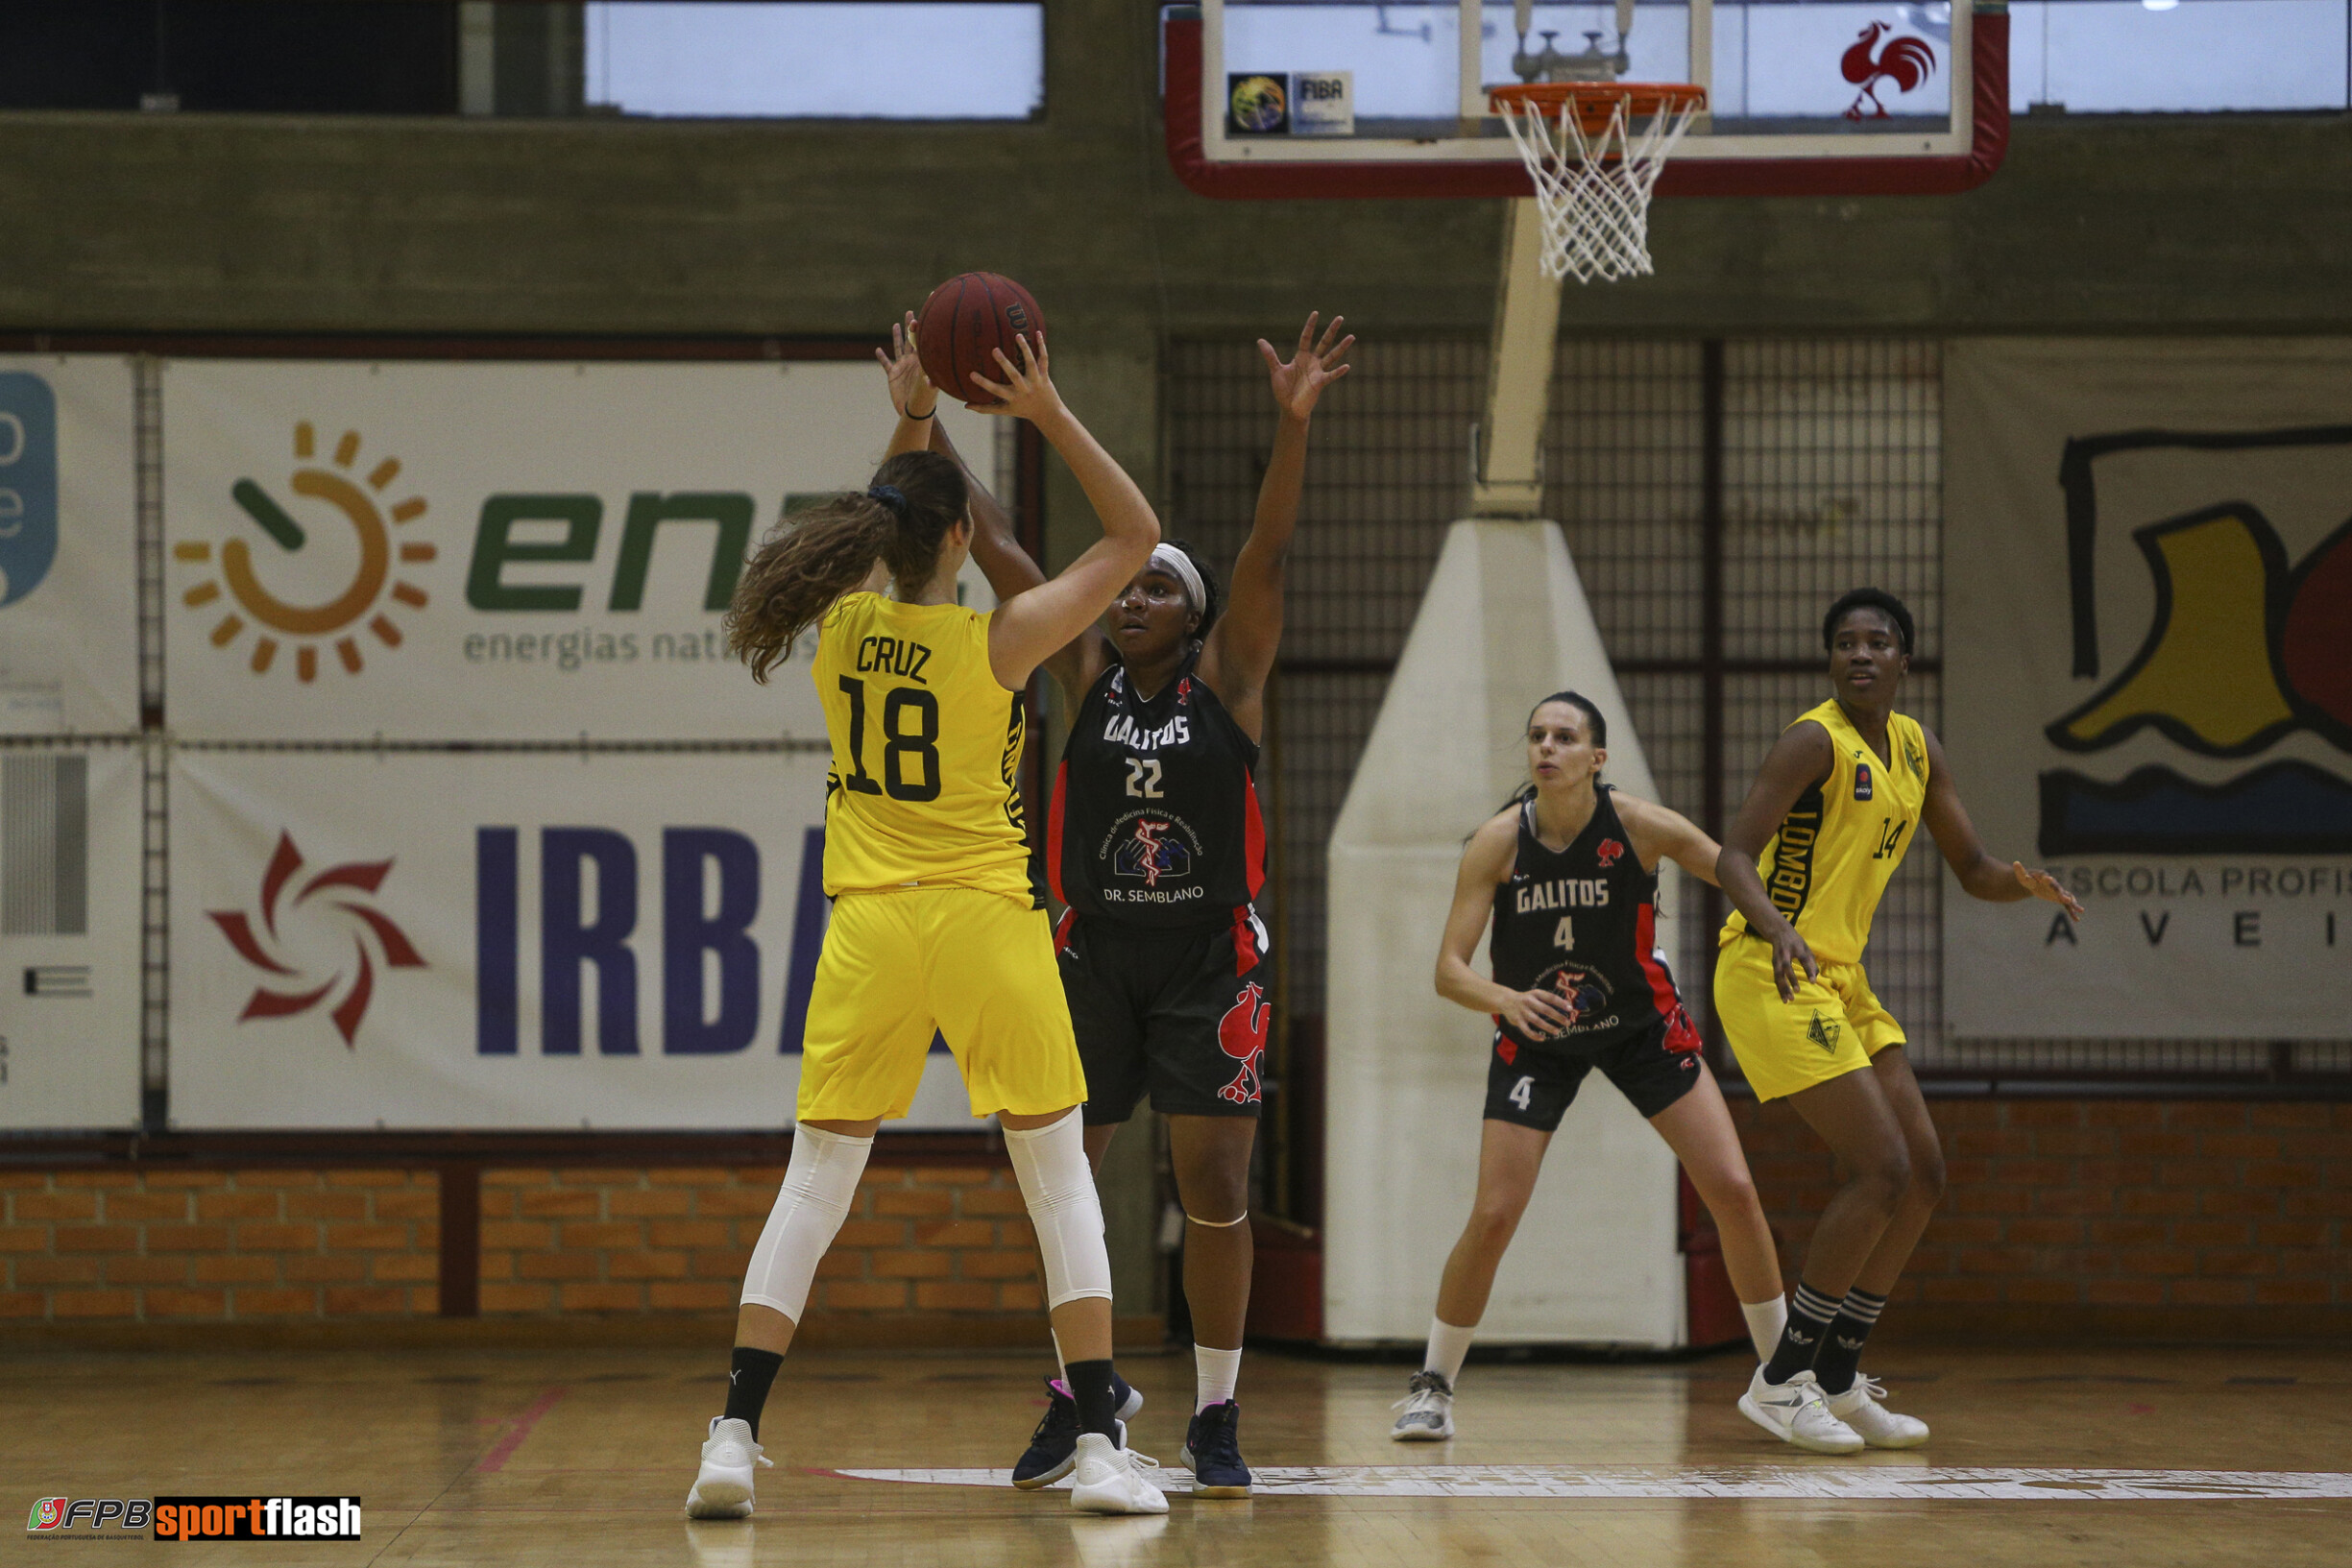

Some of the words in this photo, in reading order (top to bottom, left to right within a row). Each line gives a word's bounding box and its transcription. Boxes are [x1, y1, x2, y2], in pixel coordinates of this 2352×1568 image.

[1300, 79, 1344, 100] FIBA
[462, 629, 639, 672] energias
[857, 636, 933, 686] CRUZ
[838, 673, 942, 803] 18
[1125, 757, 1164, 799] 22
[1872, 817, 1907, 859] 14
[1104, 888, 1126, 903] DR.
[1128, 885, 1204, 904] SEMBLANO
[1515, 878, 1610, 914] GALITOS
[2220, 866, 2352, 898] PROFI
[1553, 916, 1575, 952] 4
[1509, 1074, 1535, 1111] 4
